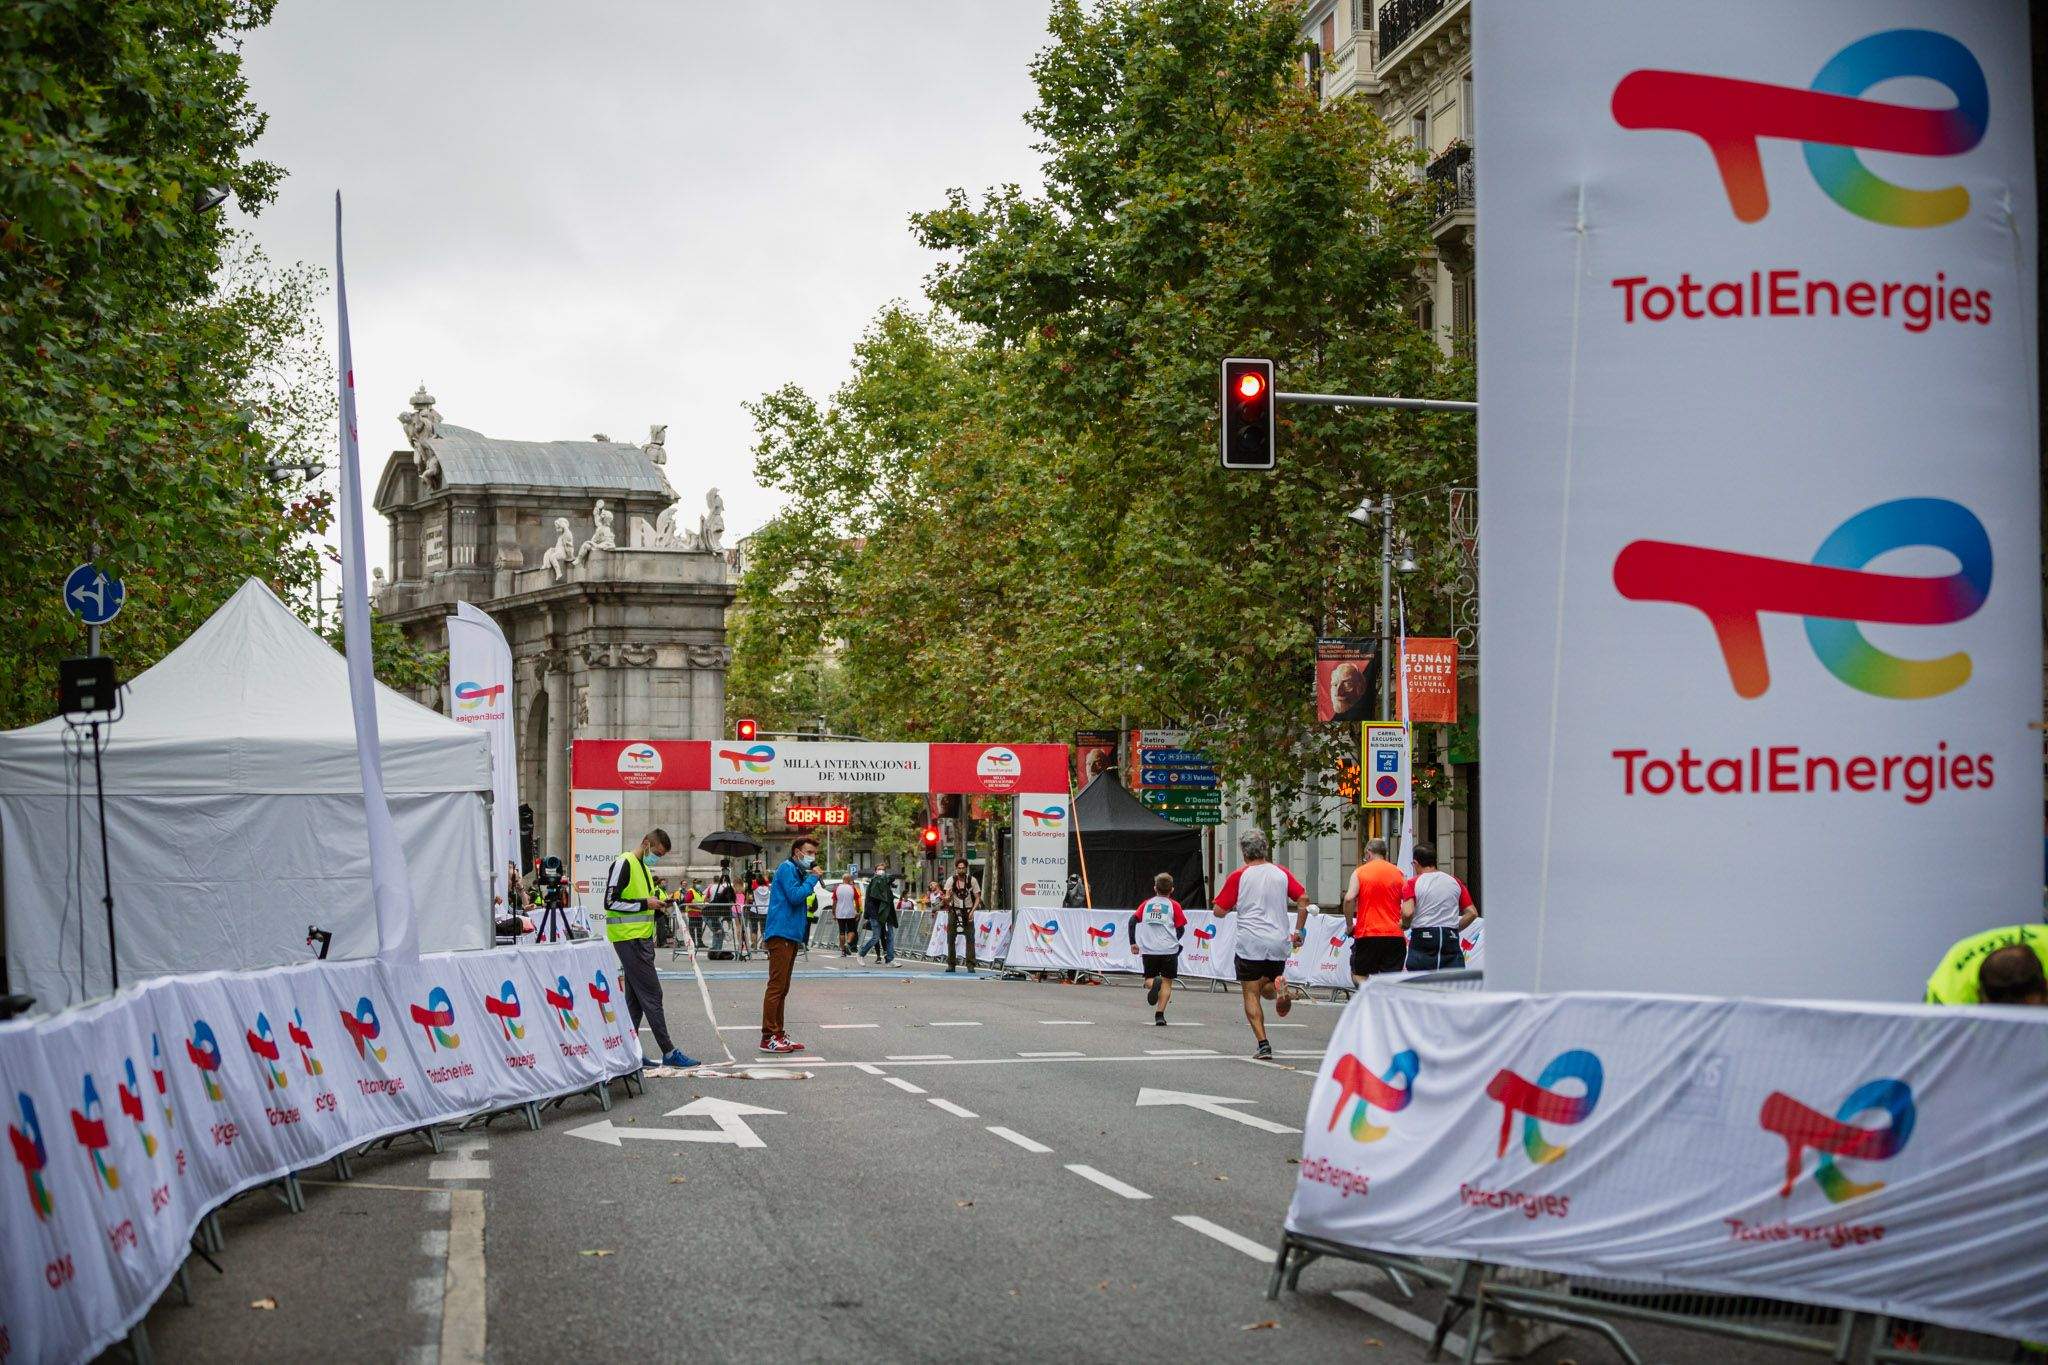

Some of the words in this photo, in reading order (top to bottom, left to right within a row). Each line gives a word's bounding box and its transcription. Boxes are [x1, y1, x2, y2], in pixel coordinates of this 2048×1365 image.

[1611, 270, 1992, 333] TotalEnergies
[783, 759, 820, 769] MILLA
[818, 771, 835, 781] DE
[838, 772, 886, 782] MADRID
[1193, 773, 1218, 781] Valenci
[1612, 742, 1994, 804] TotalEnergies
[718, 777, 775, 787] TotalEnergies
[575, 828, 619, 836] TotalEnergies
[1022, 830, 1065, 838] TotalEnergies
[1031, 857, 1066, 865] MADRID
